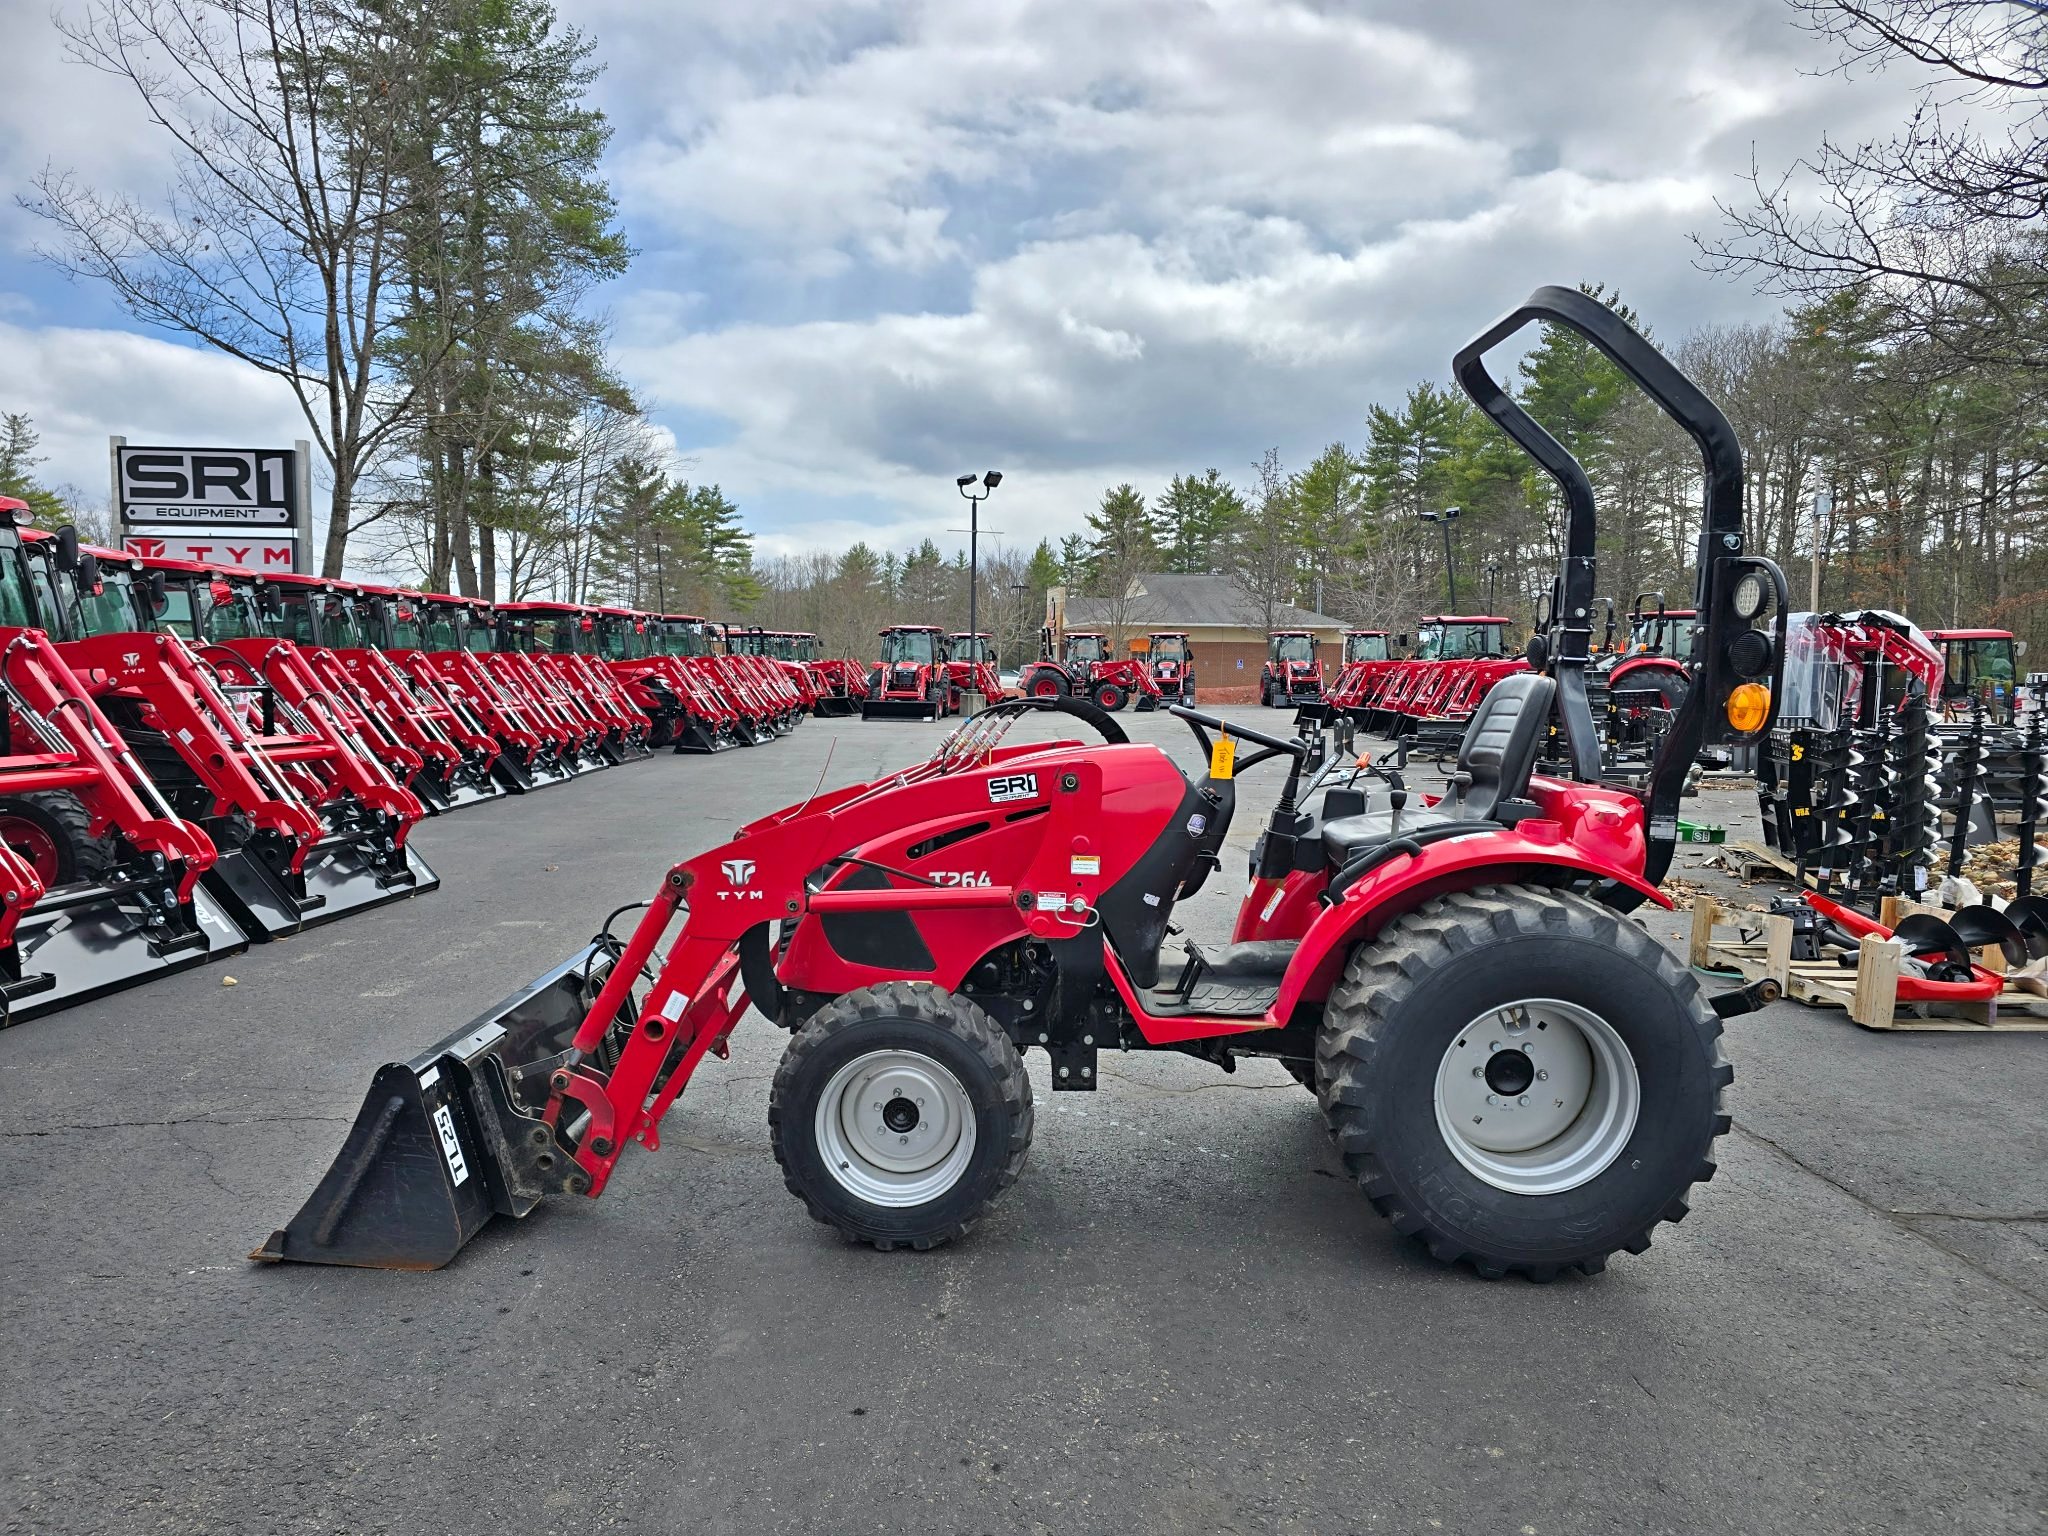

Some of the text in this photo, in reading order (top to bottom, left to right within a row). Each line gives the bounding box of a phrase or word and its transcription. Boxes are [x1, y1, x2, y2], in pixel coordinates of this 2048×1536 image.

[126, 455, 285, 502] SR1
[156, 507, 260, 519] EQUIPMENT
[187, 546, 291, 565] TYM
[990, 774, 1038, 795] SR1
[928, 870, 993, 889] T264
[716, 890, 763, 901] TYM
[437, 1110, 464, 1181] TL25
